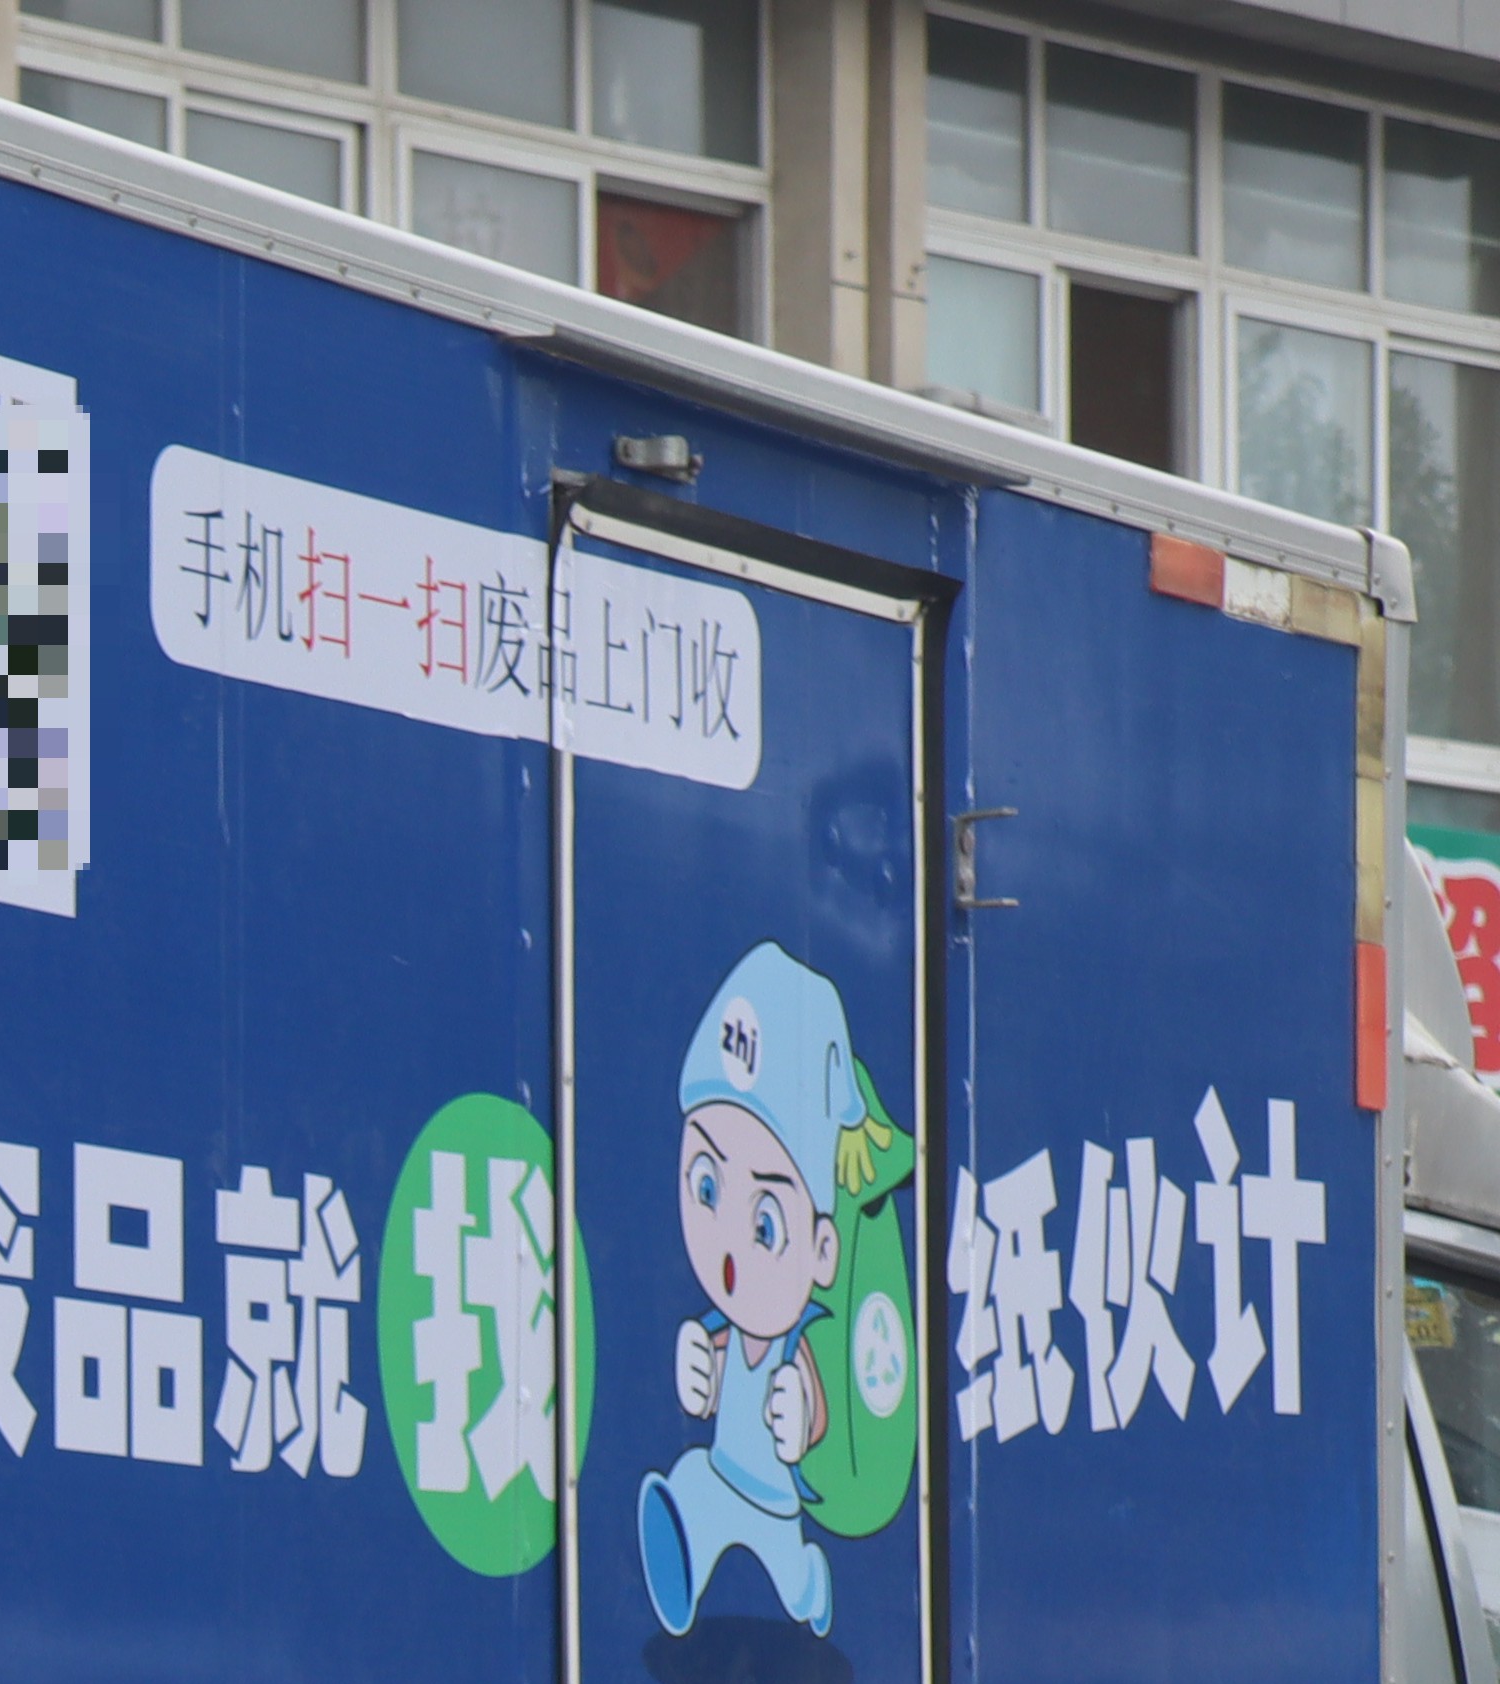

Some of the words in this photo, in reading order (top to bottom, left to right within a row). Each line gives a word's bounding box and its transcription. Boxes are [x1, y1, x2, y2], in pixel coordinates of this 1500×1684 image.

[180, 506, 742, 743] 手机扫一扫废品上门收
[722, 1018, 757, 1075] zhj
